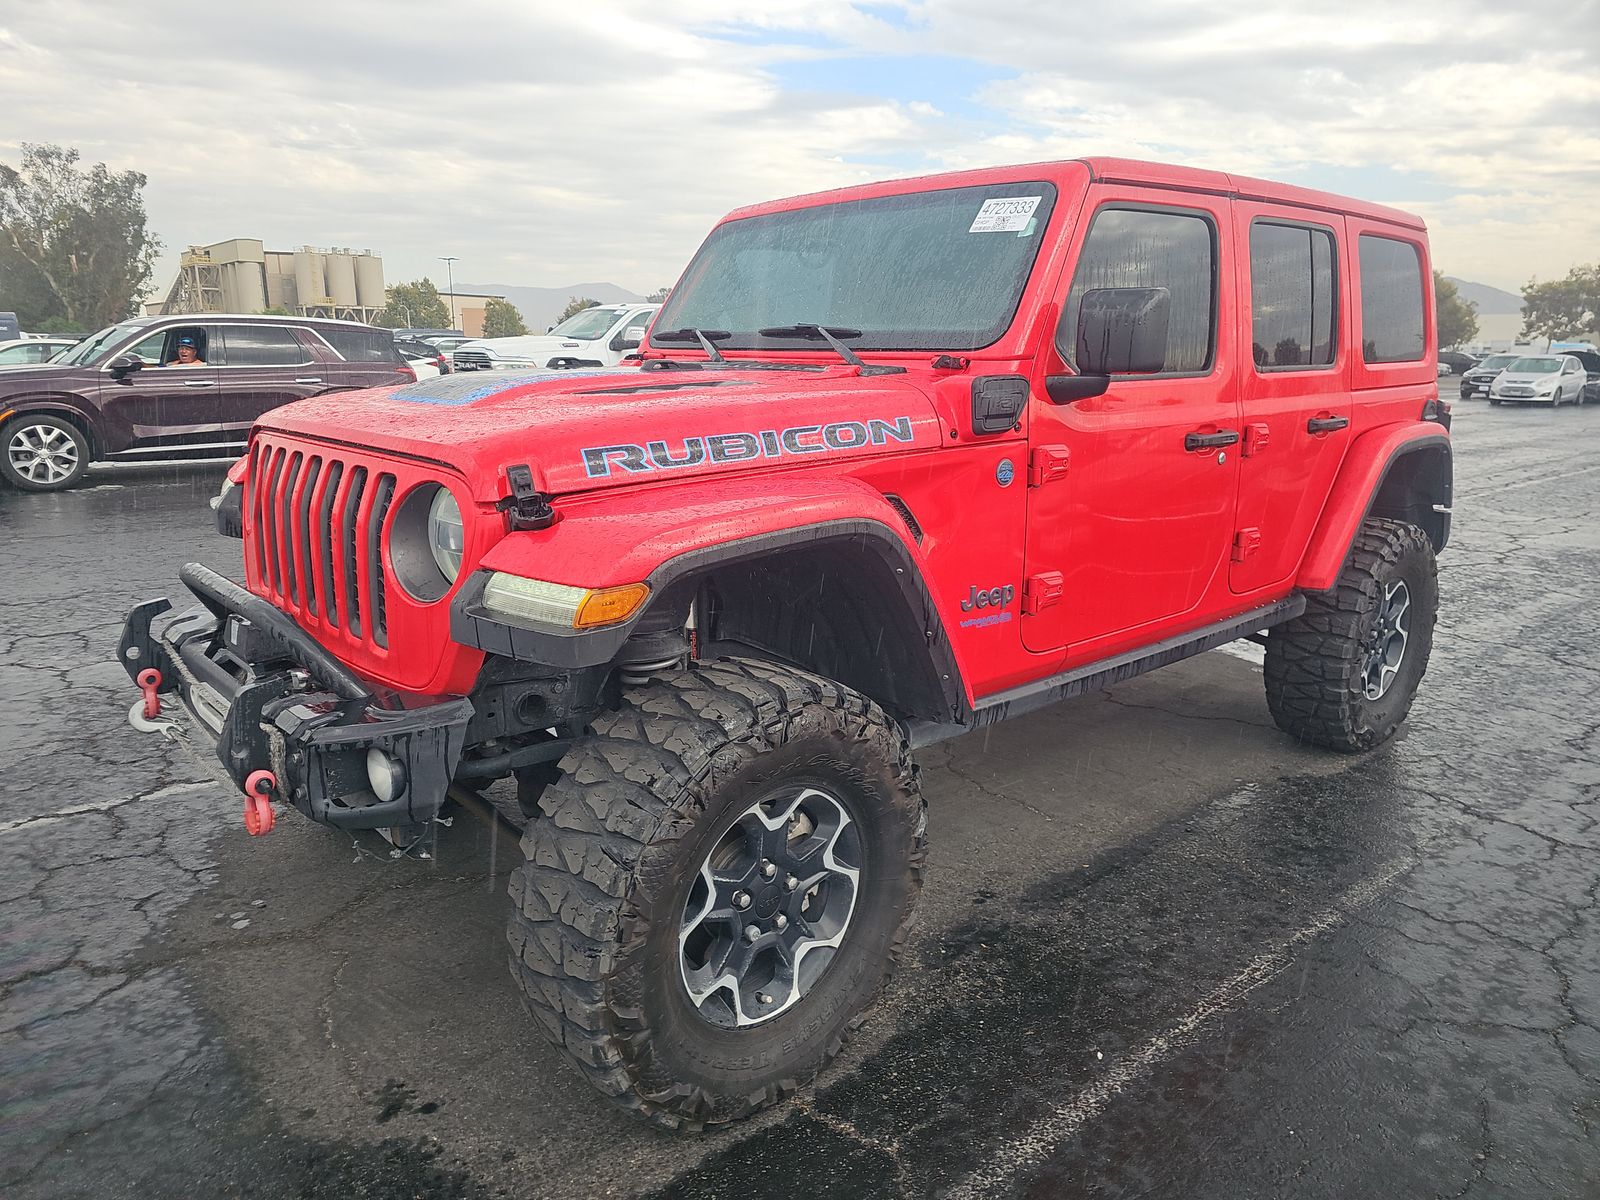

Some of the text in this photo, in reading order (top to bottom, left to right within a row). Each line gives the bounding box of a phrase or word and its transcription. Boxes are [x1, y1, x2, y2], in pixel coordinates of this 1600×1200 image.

[982, 200, 1035, 216] 4727333
[581, 416, 914, 478] RUBICON
[960, 584, 1015, 612] Jeep
